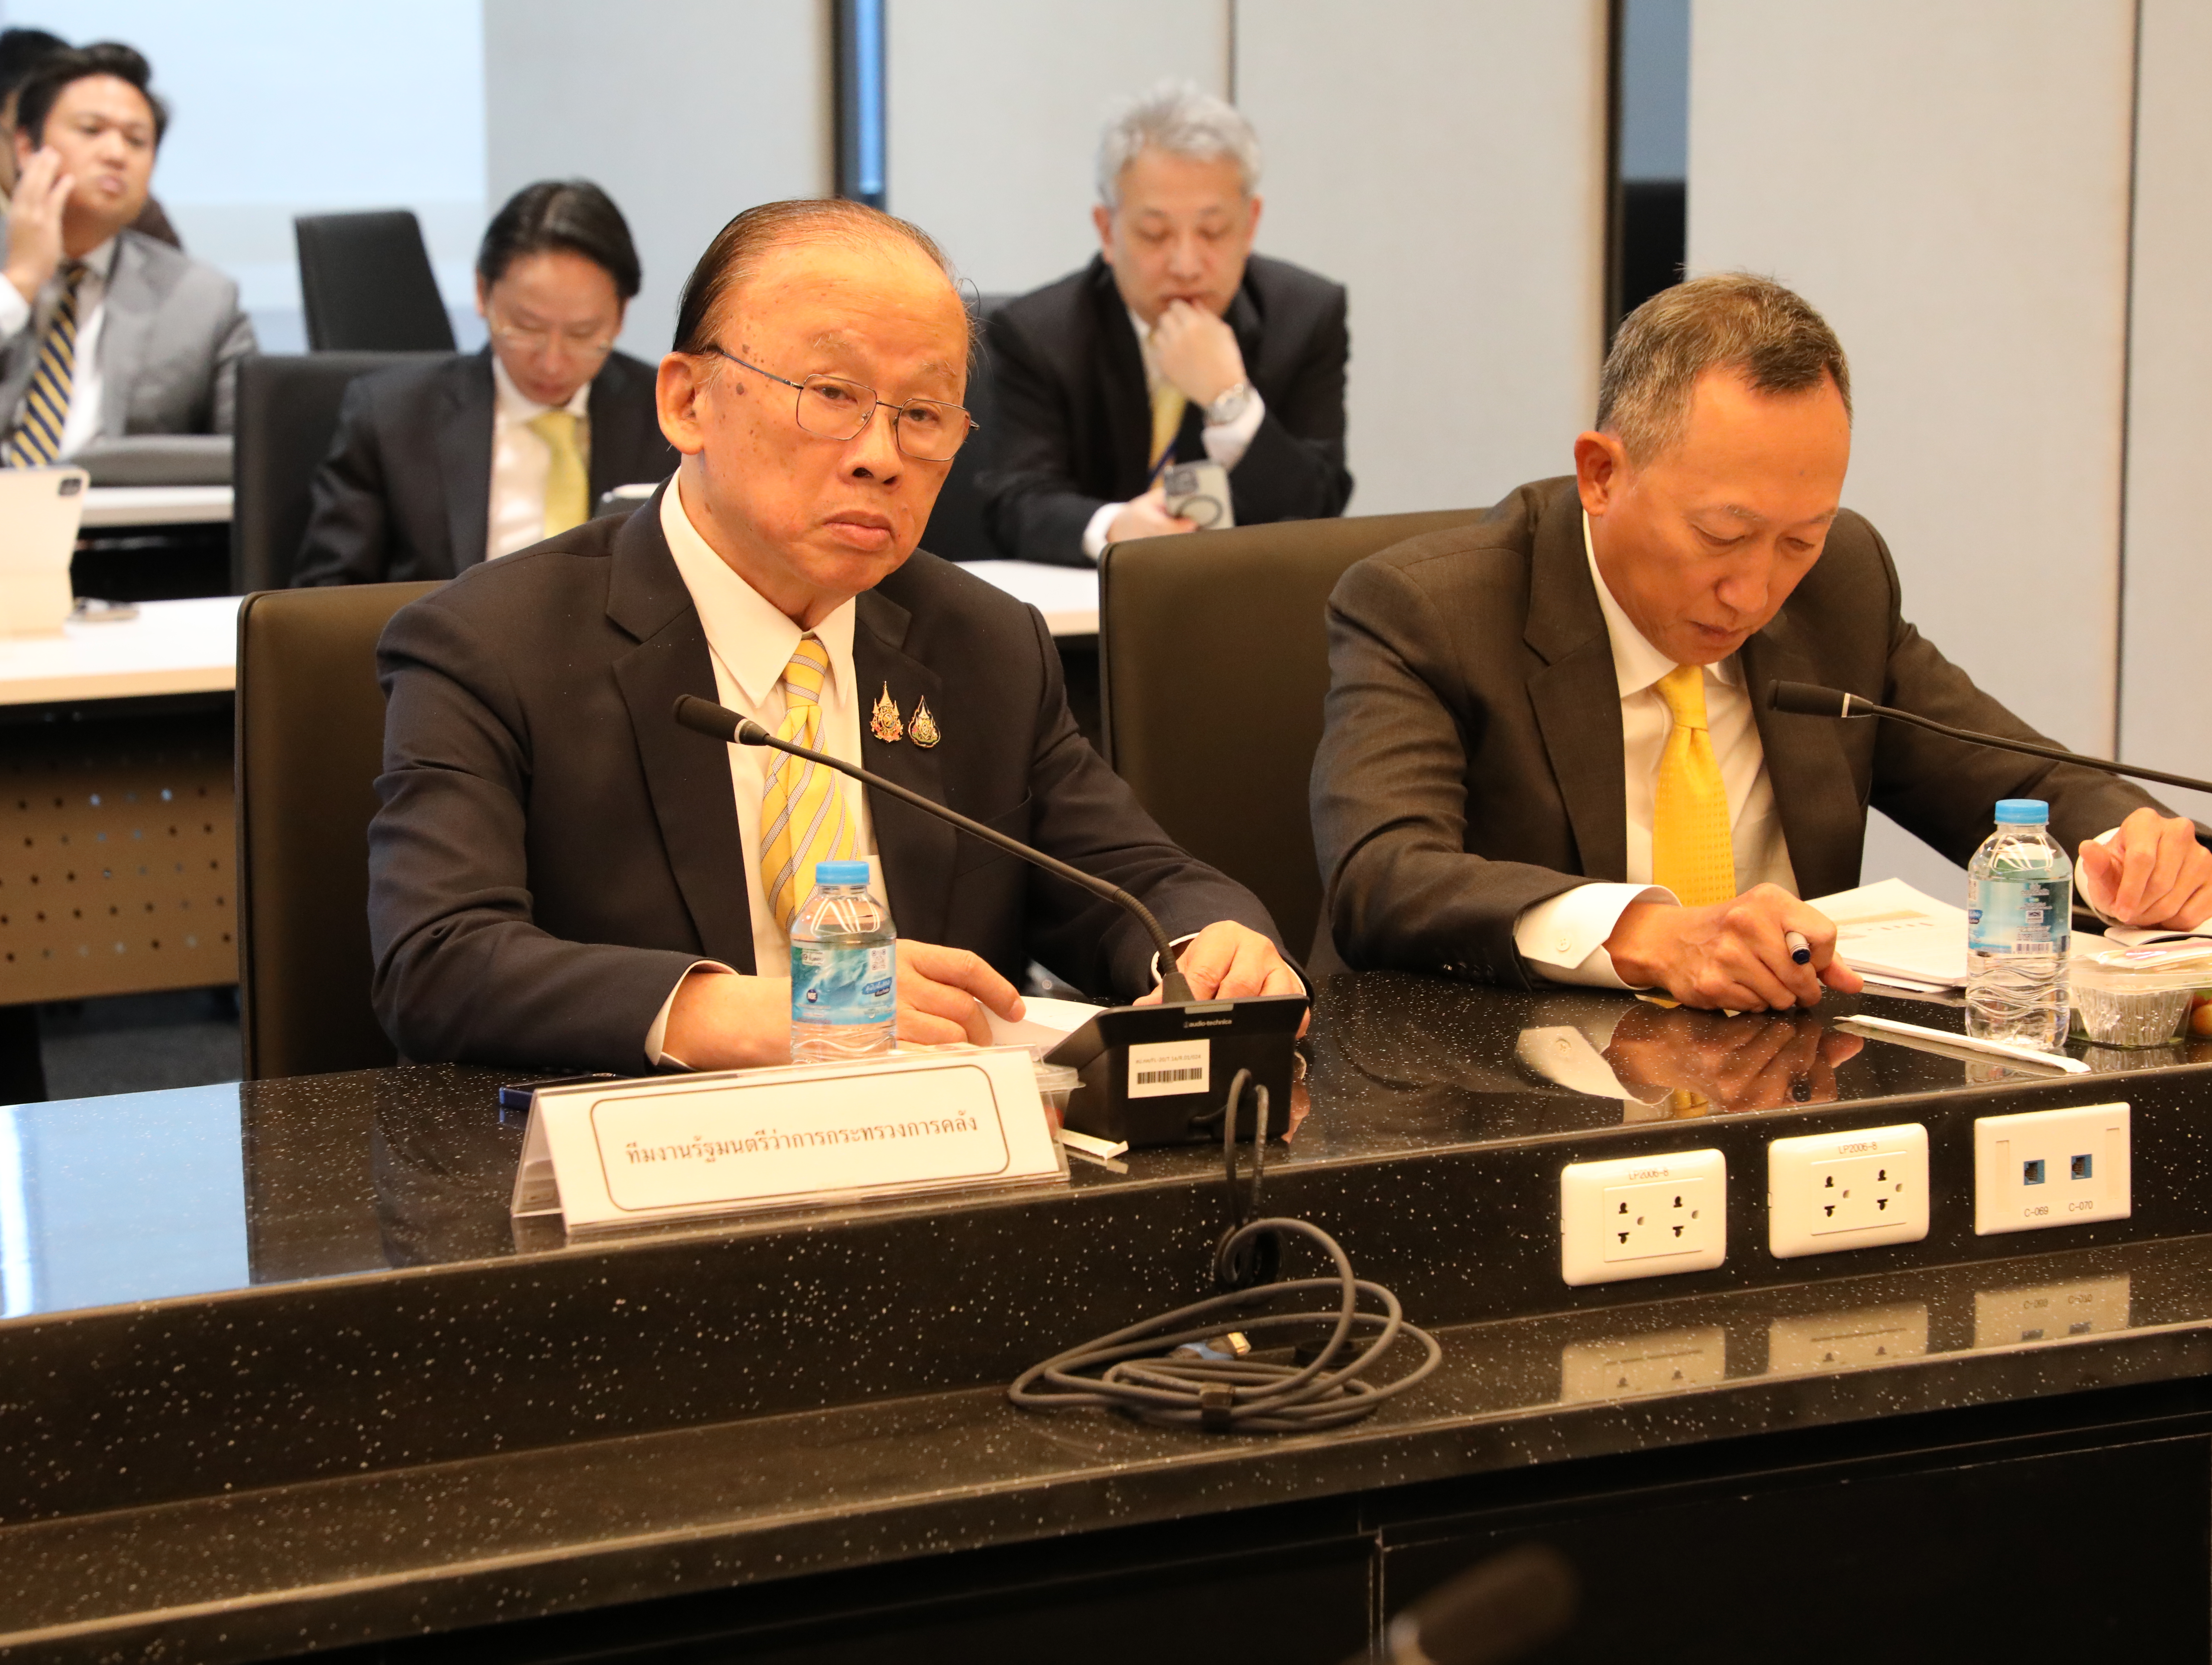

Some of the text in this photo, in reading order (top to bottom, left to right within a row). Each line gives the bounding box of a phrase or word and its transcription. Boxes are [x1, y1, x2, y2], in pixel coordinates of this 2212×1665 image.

[626, 1110, 977, 1164] ทีมงานรัฐมนตรีว่าการกระทรวงการคลัง
[1839, 1142, 1877, 1154] LP2006-8
[2024, 1200, 2093, 1217] C-069 C-070
